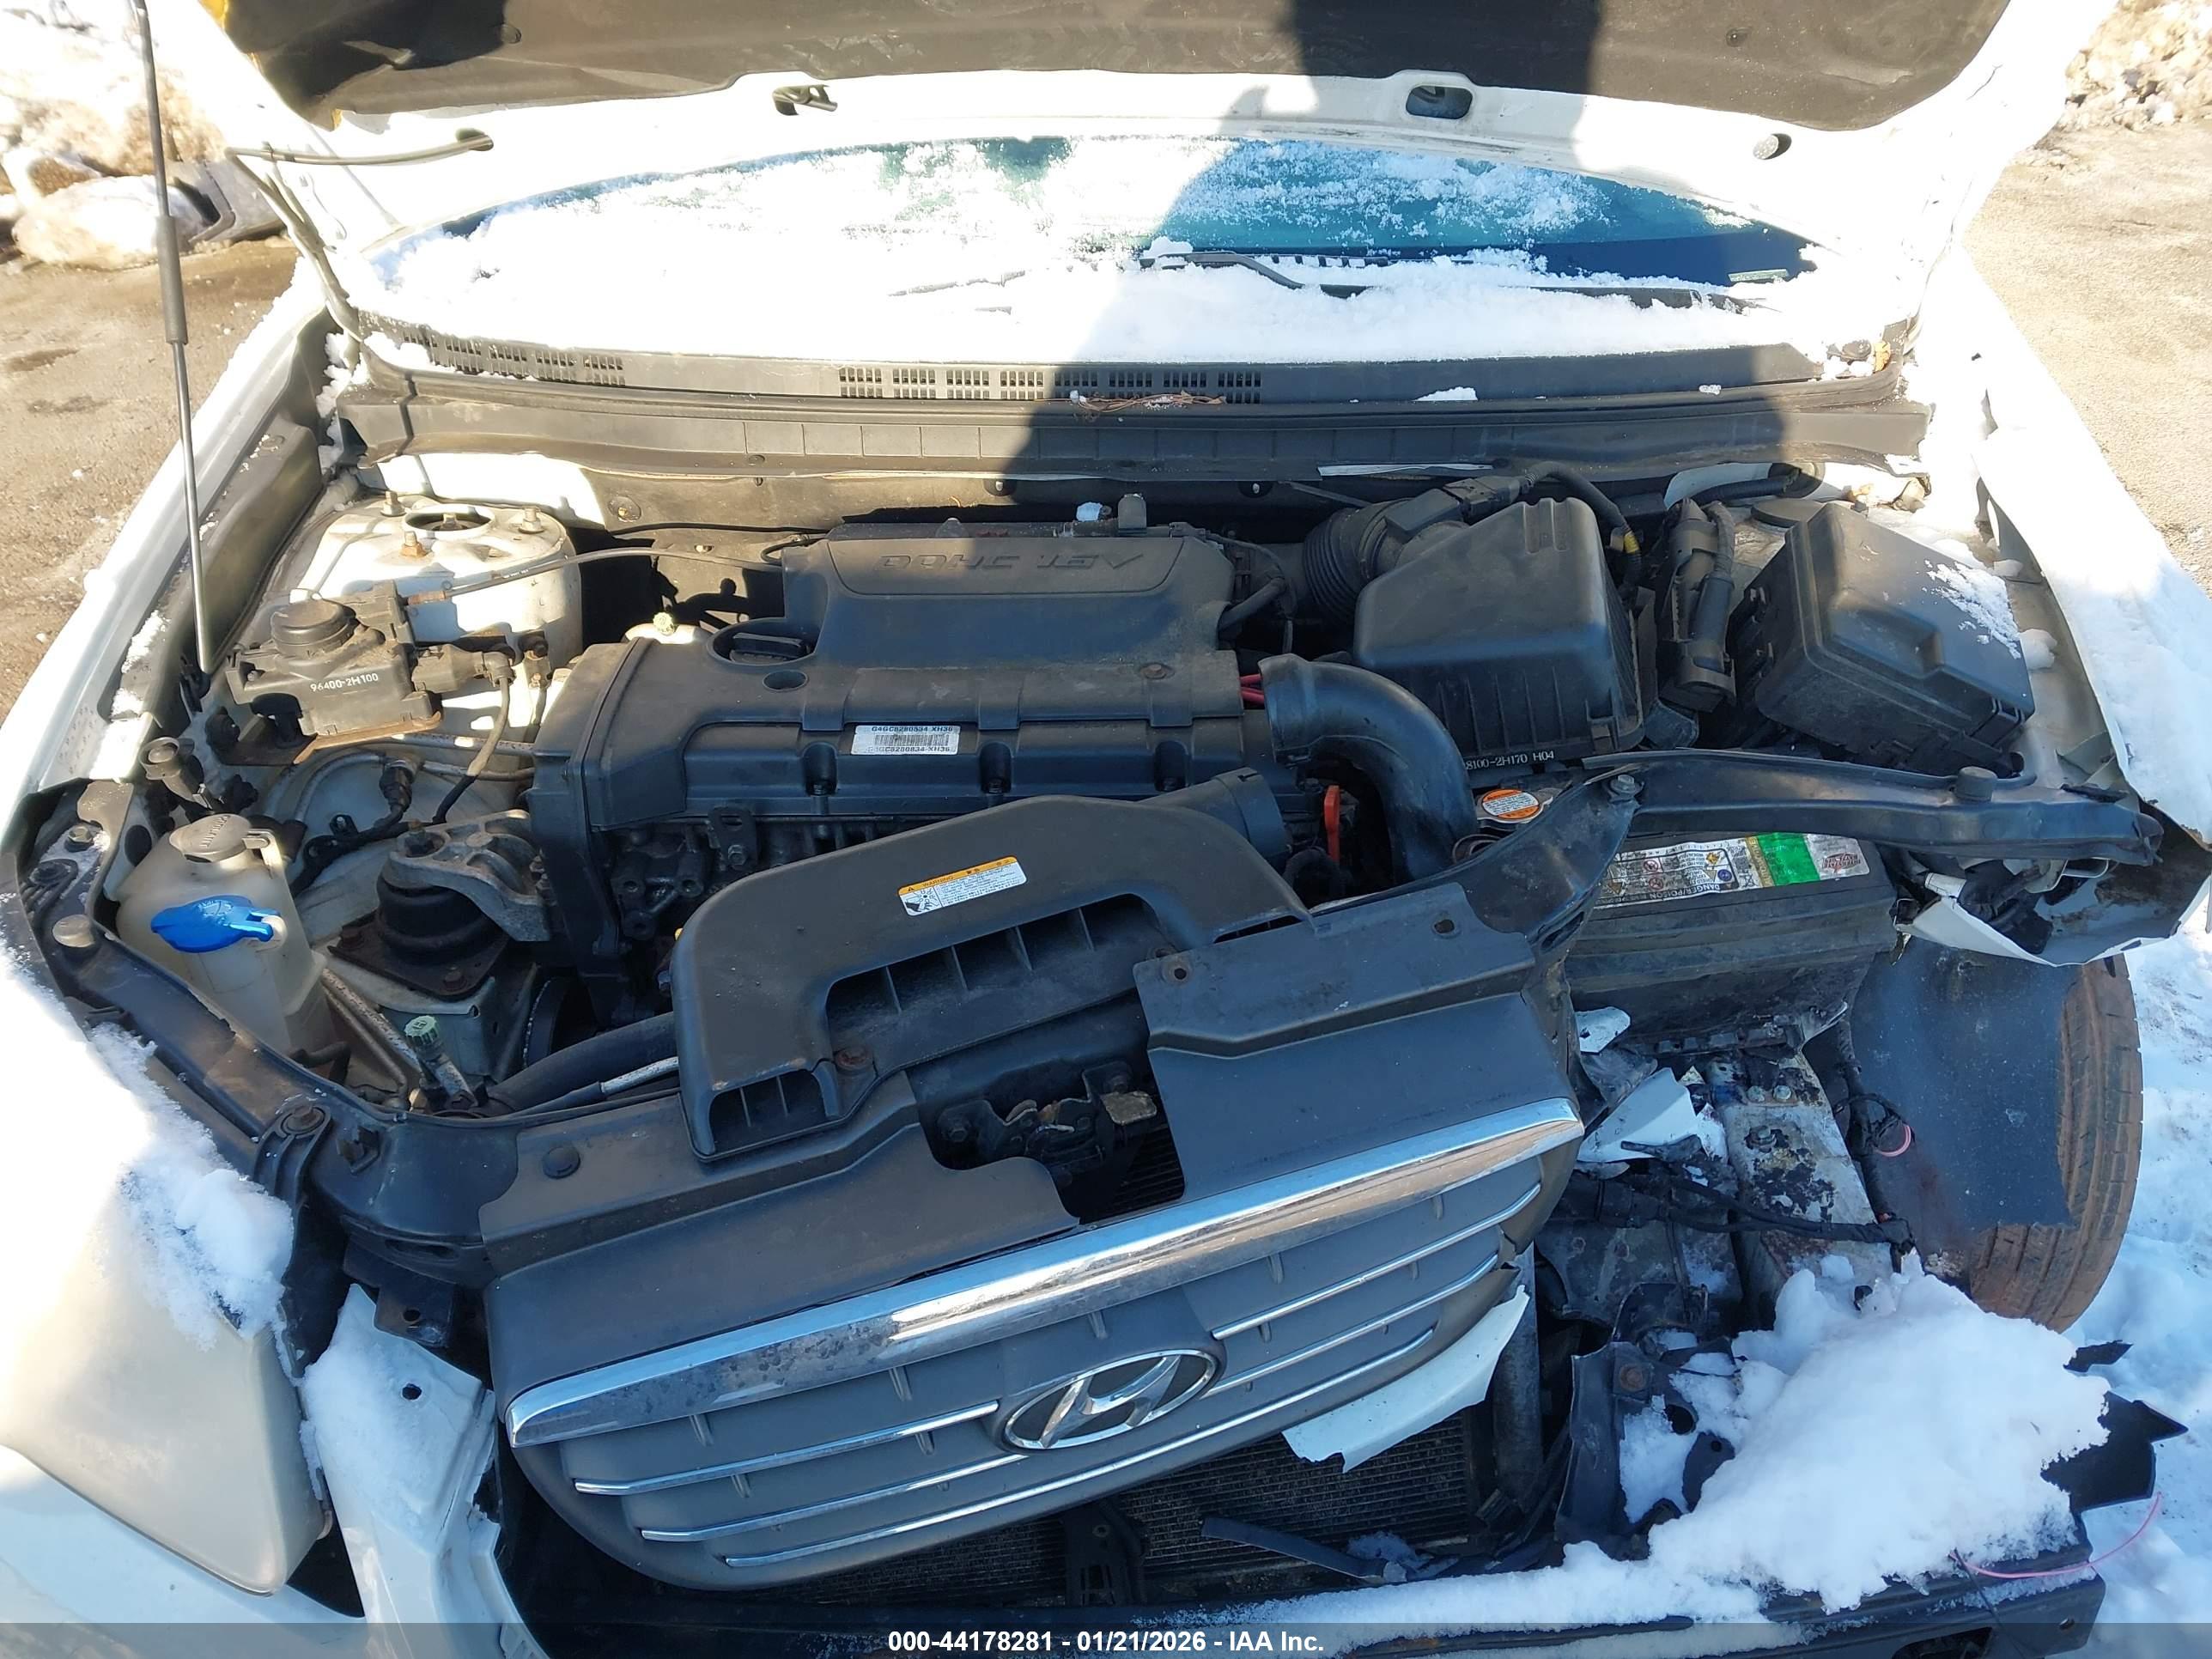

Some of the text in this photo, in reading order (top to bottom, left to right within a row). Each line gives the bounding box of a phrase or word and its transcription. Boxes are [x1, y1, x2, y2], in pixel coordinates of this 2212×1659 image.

[874, 553, 1144, 571] DOHC 16V
[310, 673, 379, 692] 96400-2H100
[1466, 750, 1554, 770] 8100-2H170 H04
[921, 876, 953, 887] WARNING
[1649, 884, 1721, 899] DANGER/POISON
